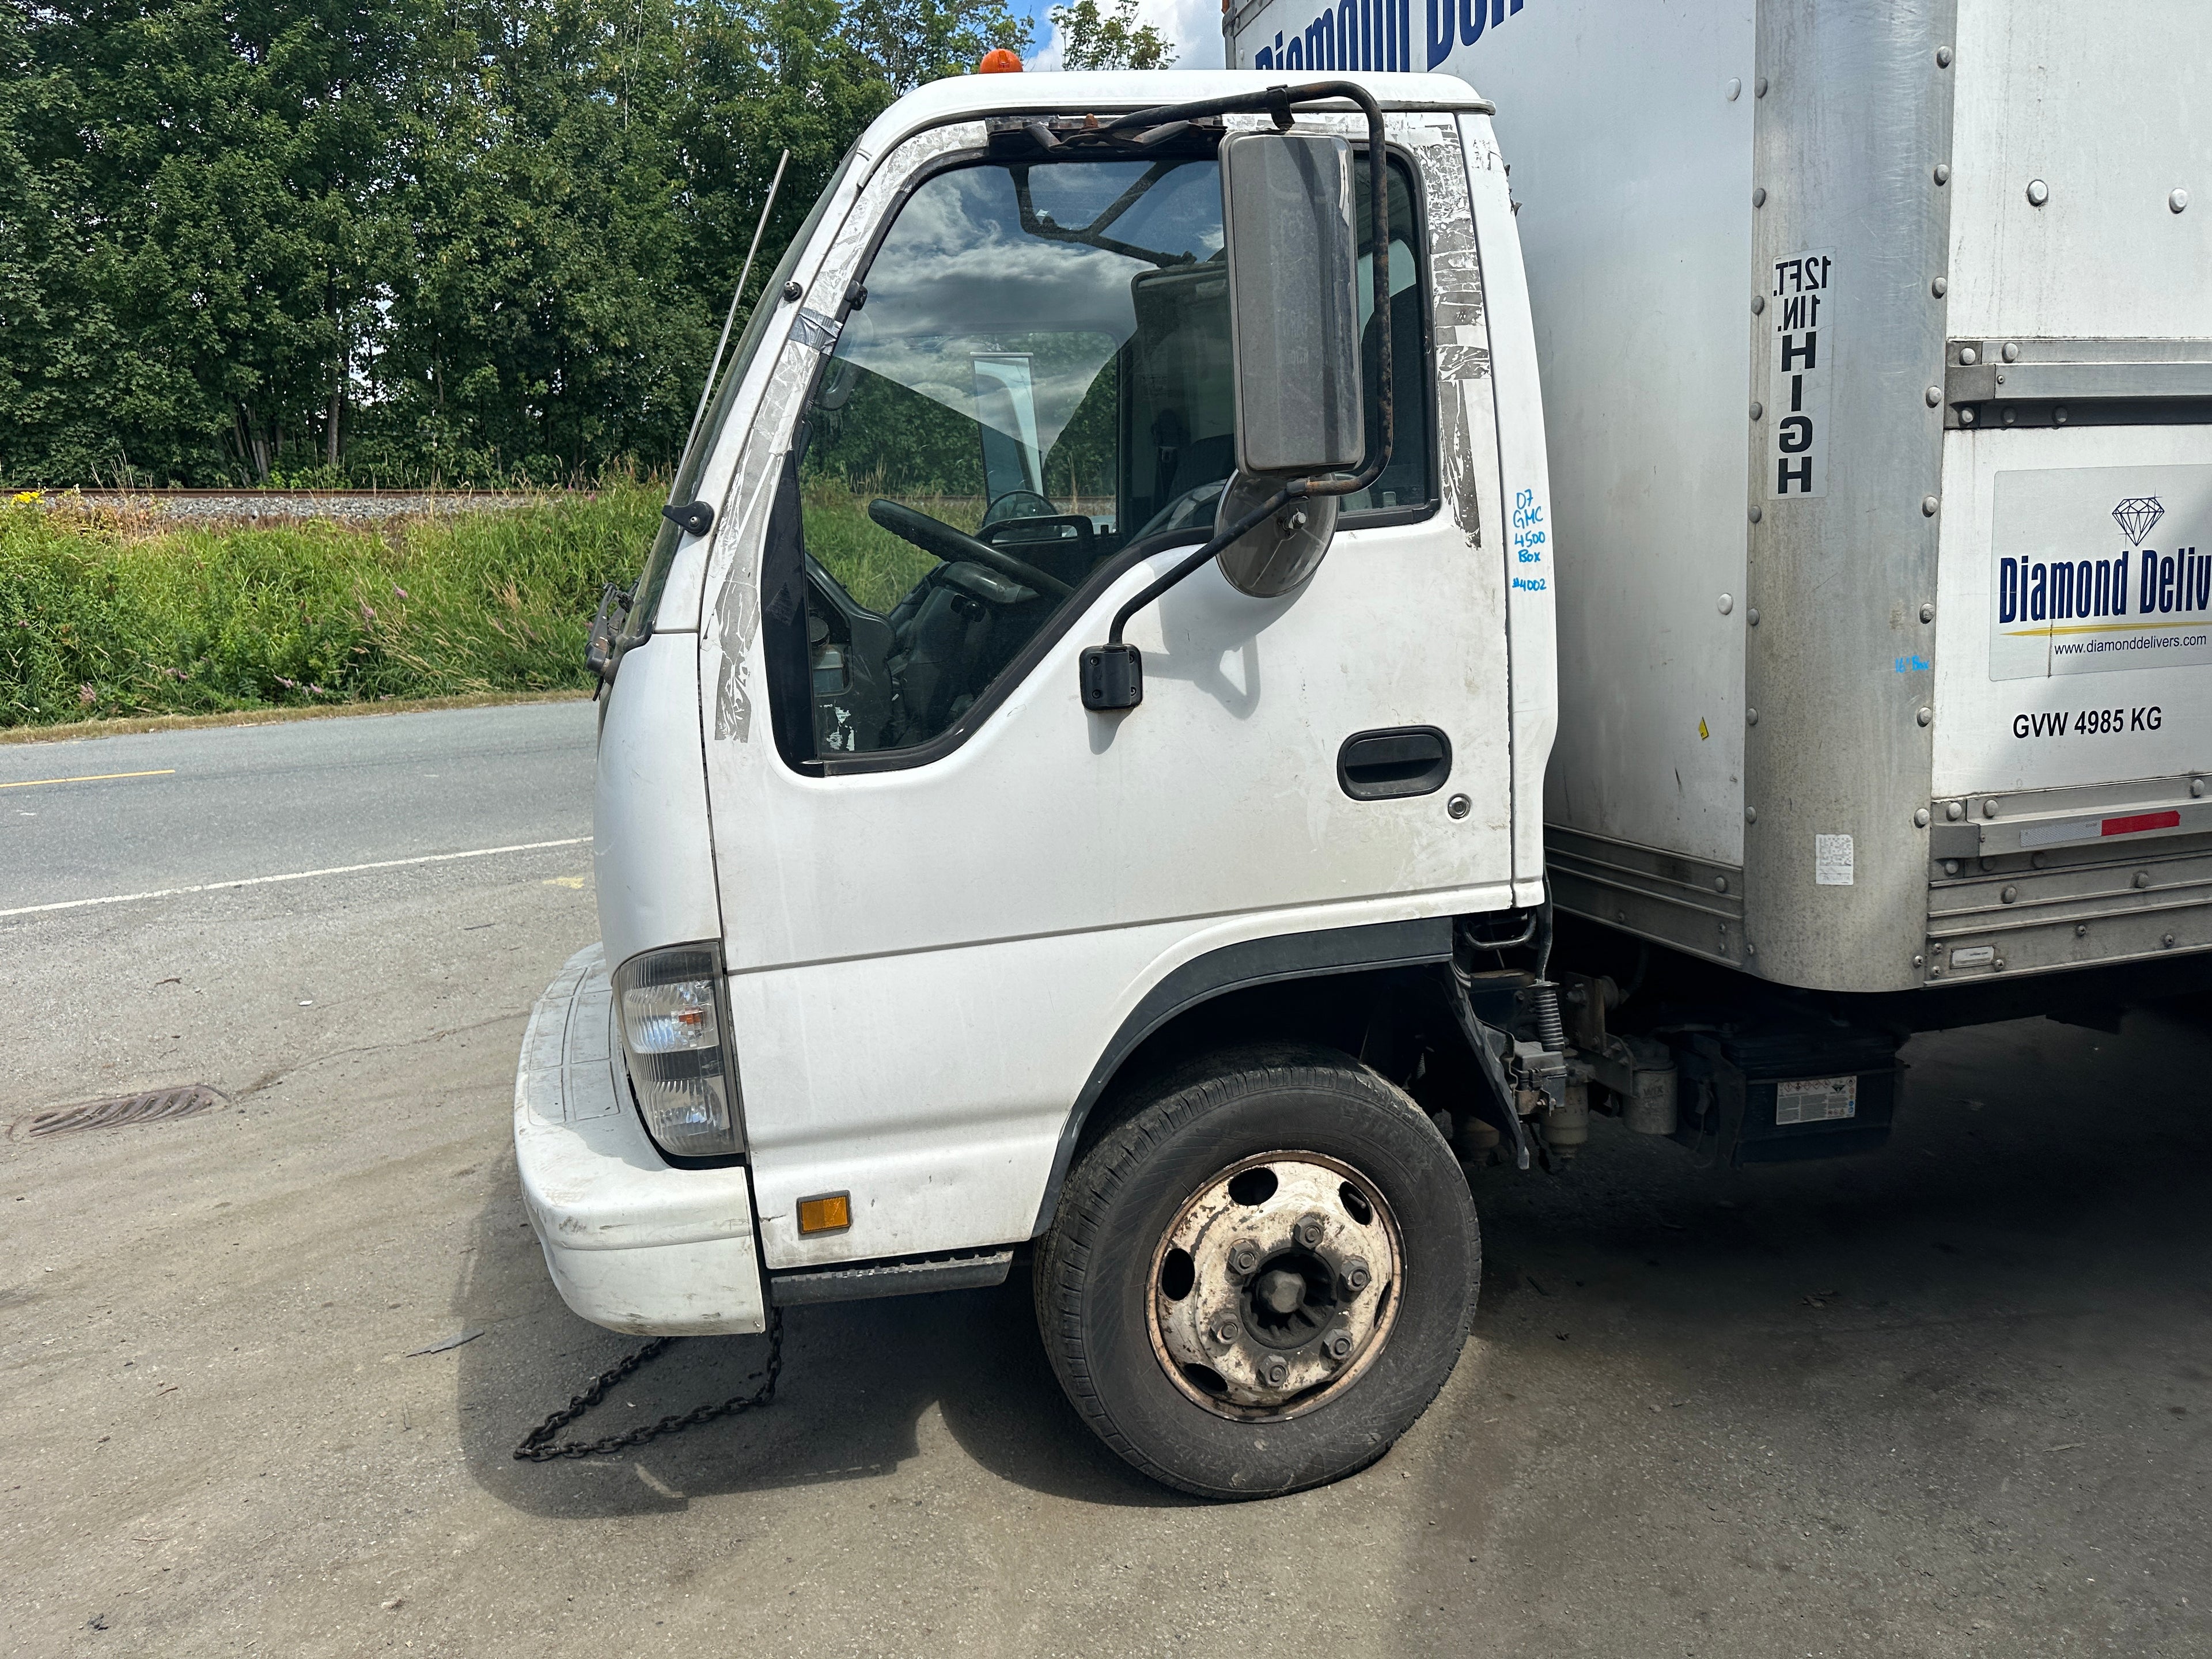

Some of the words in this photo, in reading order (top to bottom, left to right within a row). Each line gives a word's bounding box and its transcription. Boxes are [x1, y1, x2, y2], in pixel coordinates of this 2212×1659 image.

[1513, 506, 1543, 529] GMC
[1514, 531, 1546, 548] 4500
[1518, 549, 1540, 563] Box
[1512, 577, 1546, 592] #4002
[1999, 551, 2128, 623] Diamond
[2139, 547, 2211, 614] Deliv
[2054, 635, 2206, 655] www.diamonddelivers.com
[2013, 712, 2069, 738] GVW
[2074, 709, 2124, 735] 4985
[2131, 706, 2162, 732] KG
